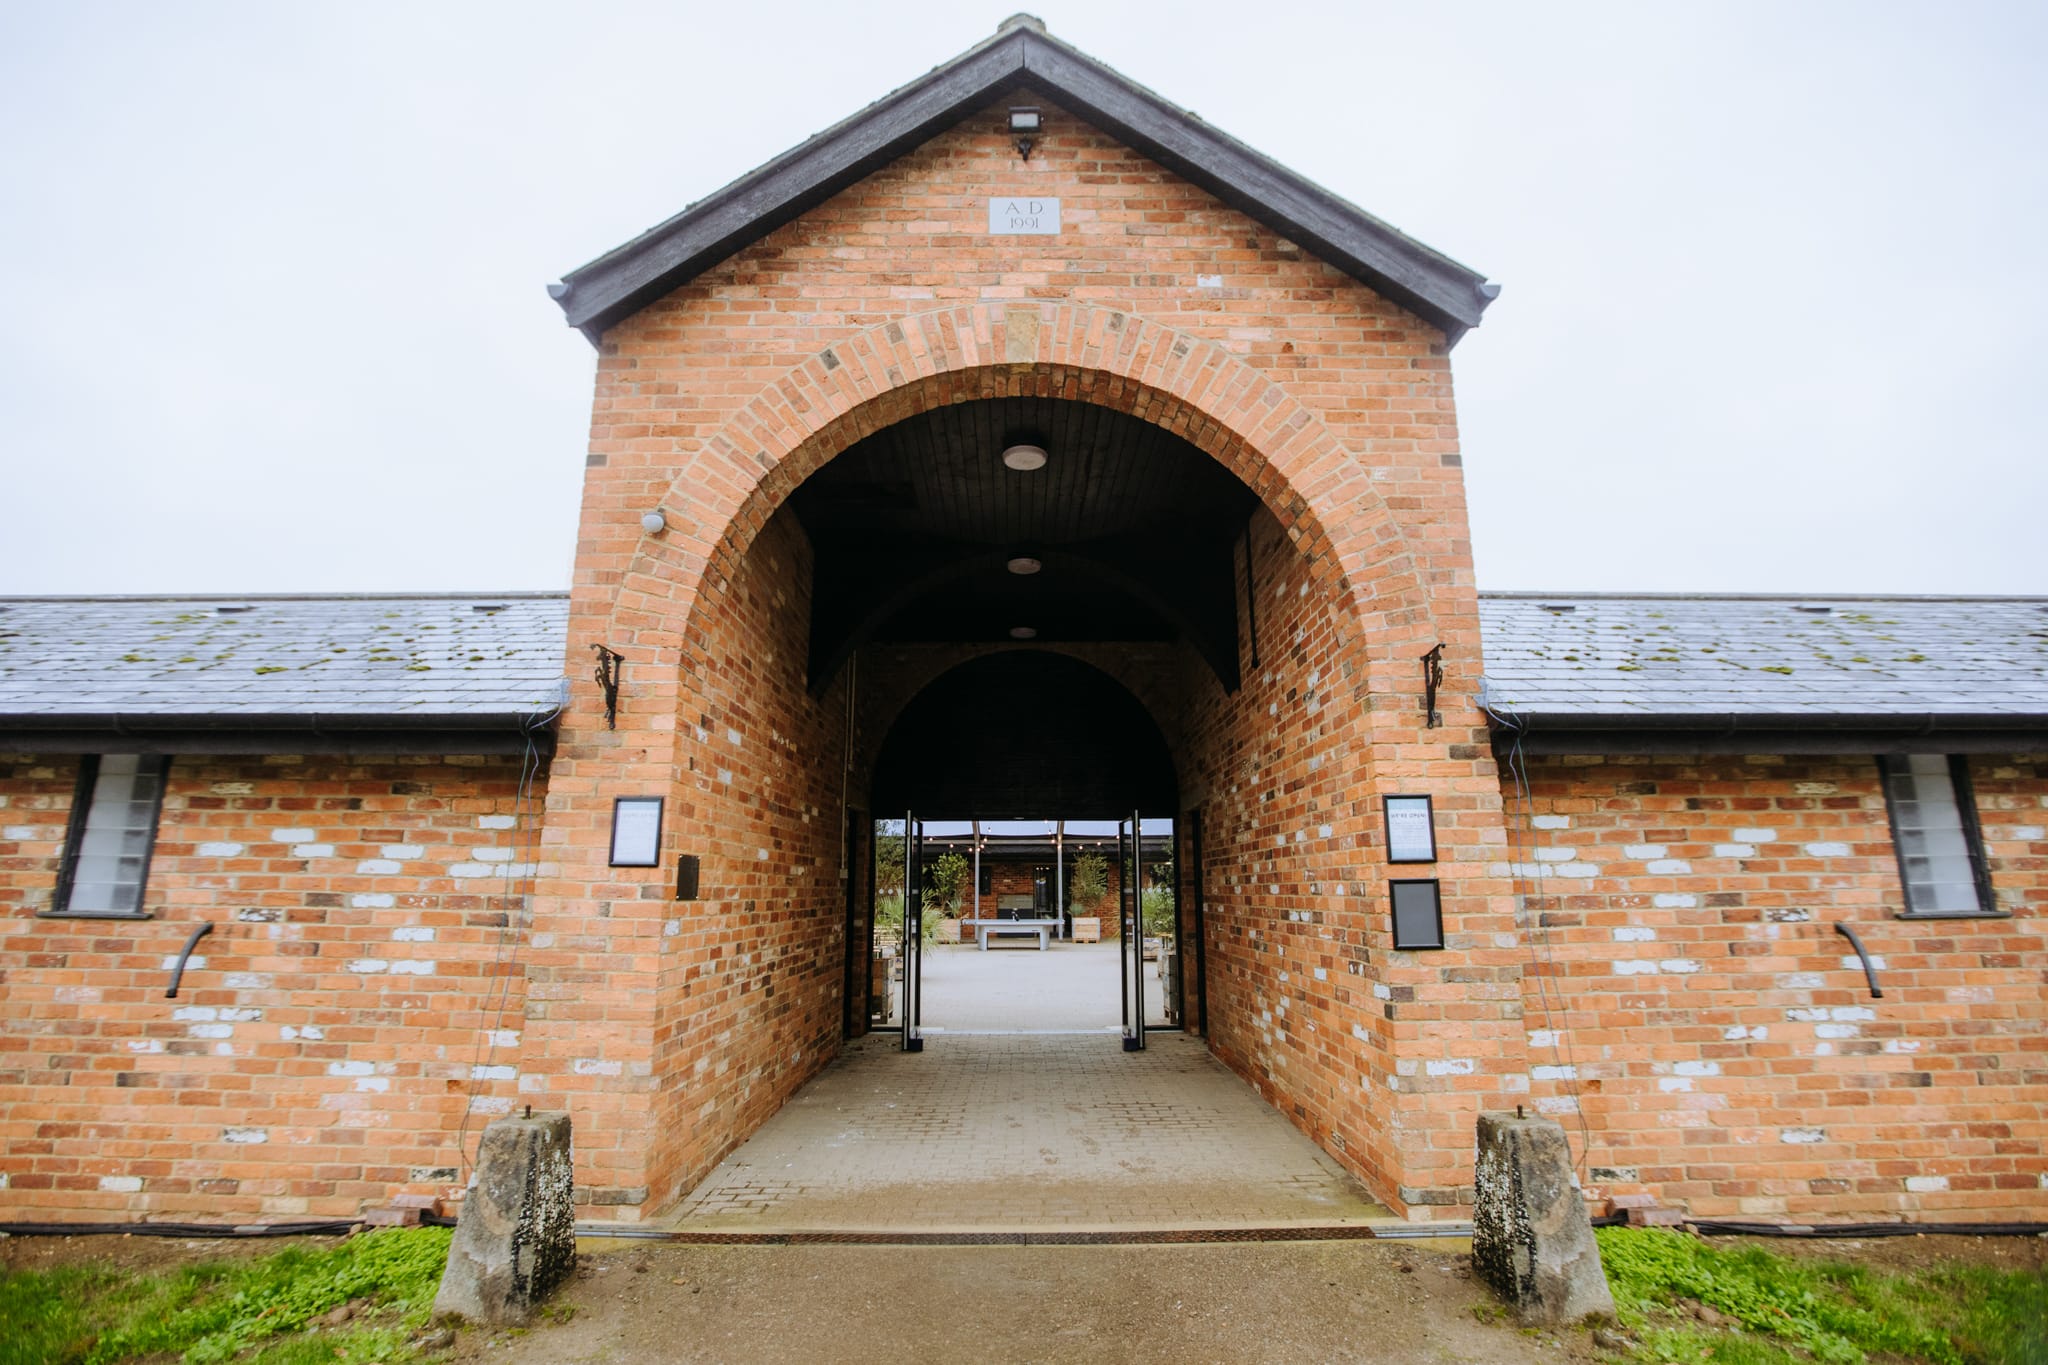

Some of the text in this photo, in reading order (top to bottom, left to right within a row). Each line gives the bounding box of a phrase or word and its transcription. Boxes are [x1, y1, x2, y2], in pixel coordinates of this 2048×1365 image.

[1005, 201, 1043, 215] A D
[1010, 217, 1039, 229] 1991
